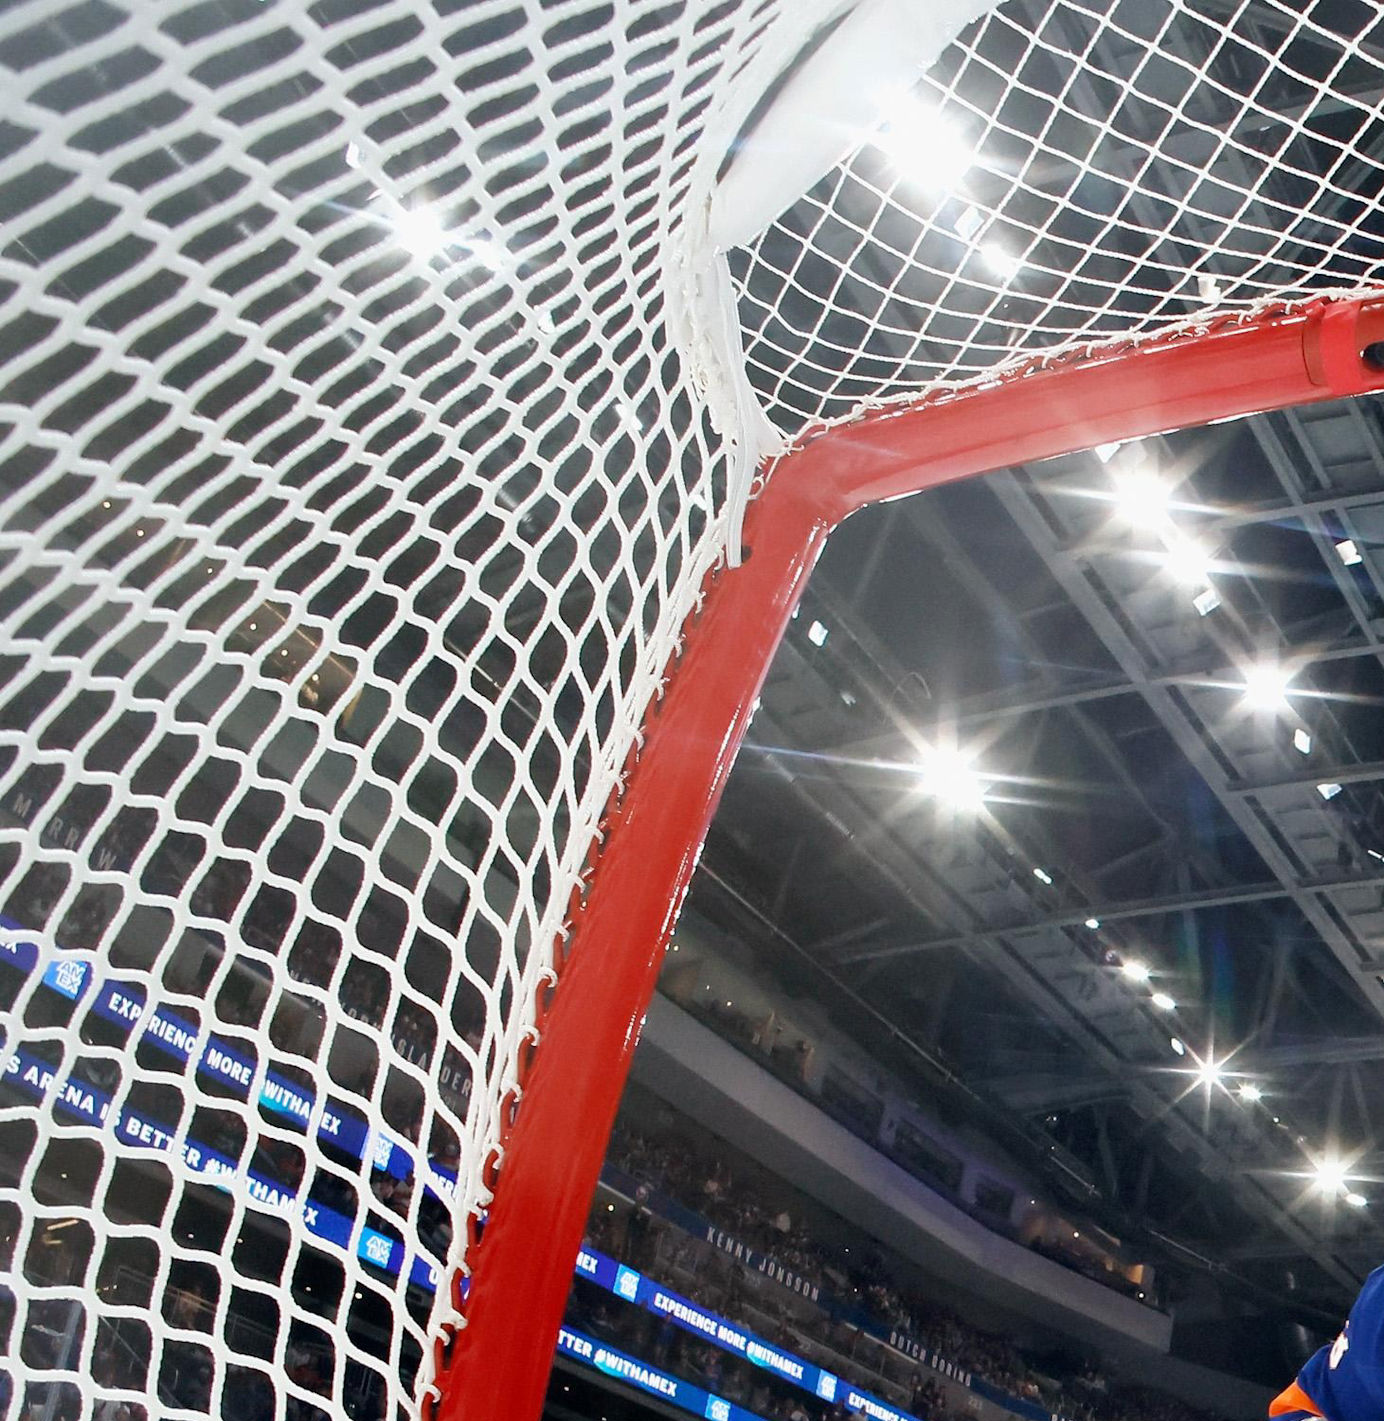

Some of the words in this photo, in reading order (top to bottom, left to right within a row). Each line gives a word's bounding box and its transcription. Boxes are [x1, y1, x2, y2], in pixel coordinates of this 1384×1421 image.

[108, 992, 208, 1060] EXPRIENC
[206, 1048, 253, 1086] MORE
[261, 1077, 342, 1135] WITHAEX
[707, 1226, 752, 1264] KENNY
[759, 1258, 819, 1302] JONSSON
[558, 1329, 593, 1359] TTER
[593, 1348, 678, 1398] #WITHAMEX
[654, 1292, 718, 1336] EXPERIENCE
[718, 1325, 747, 1351] MORE
[747, 1341, 804, 1380] #WITHAMEX
